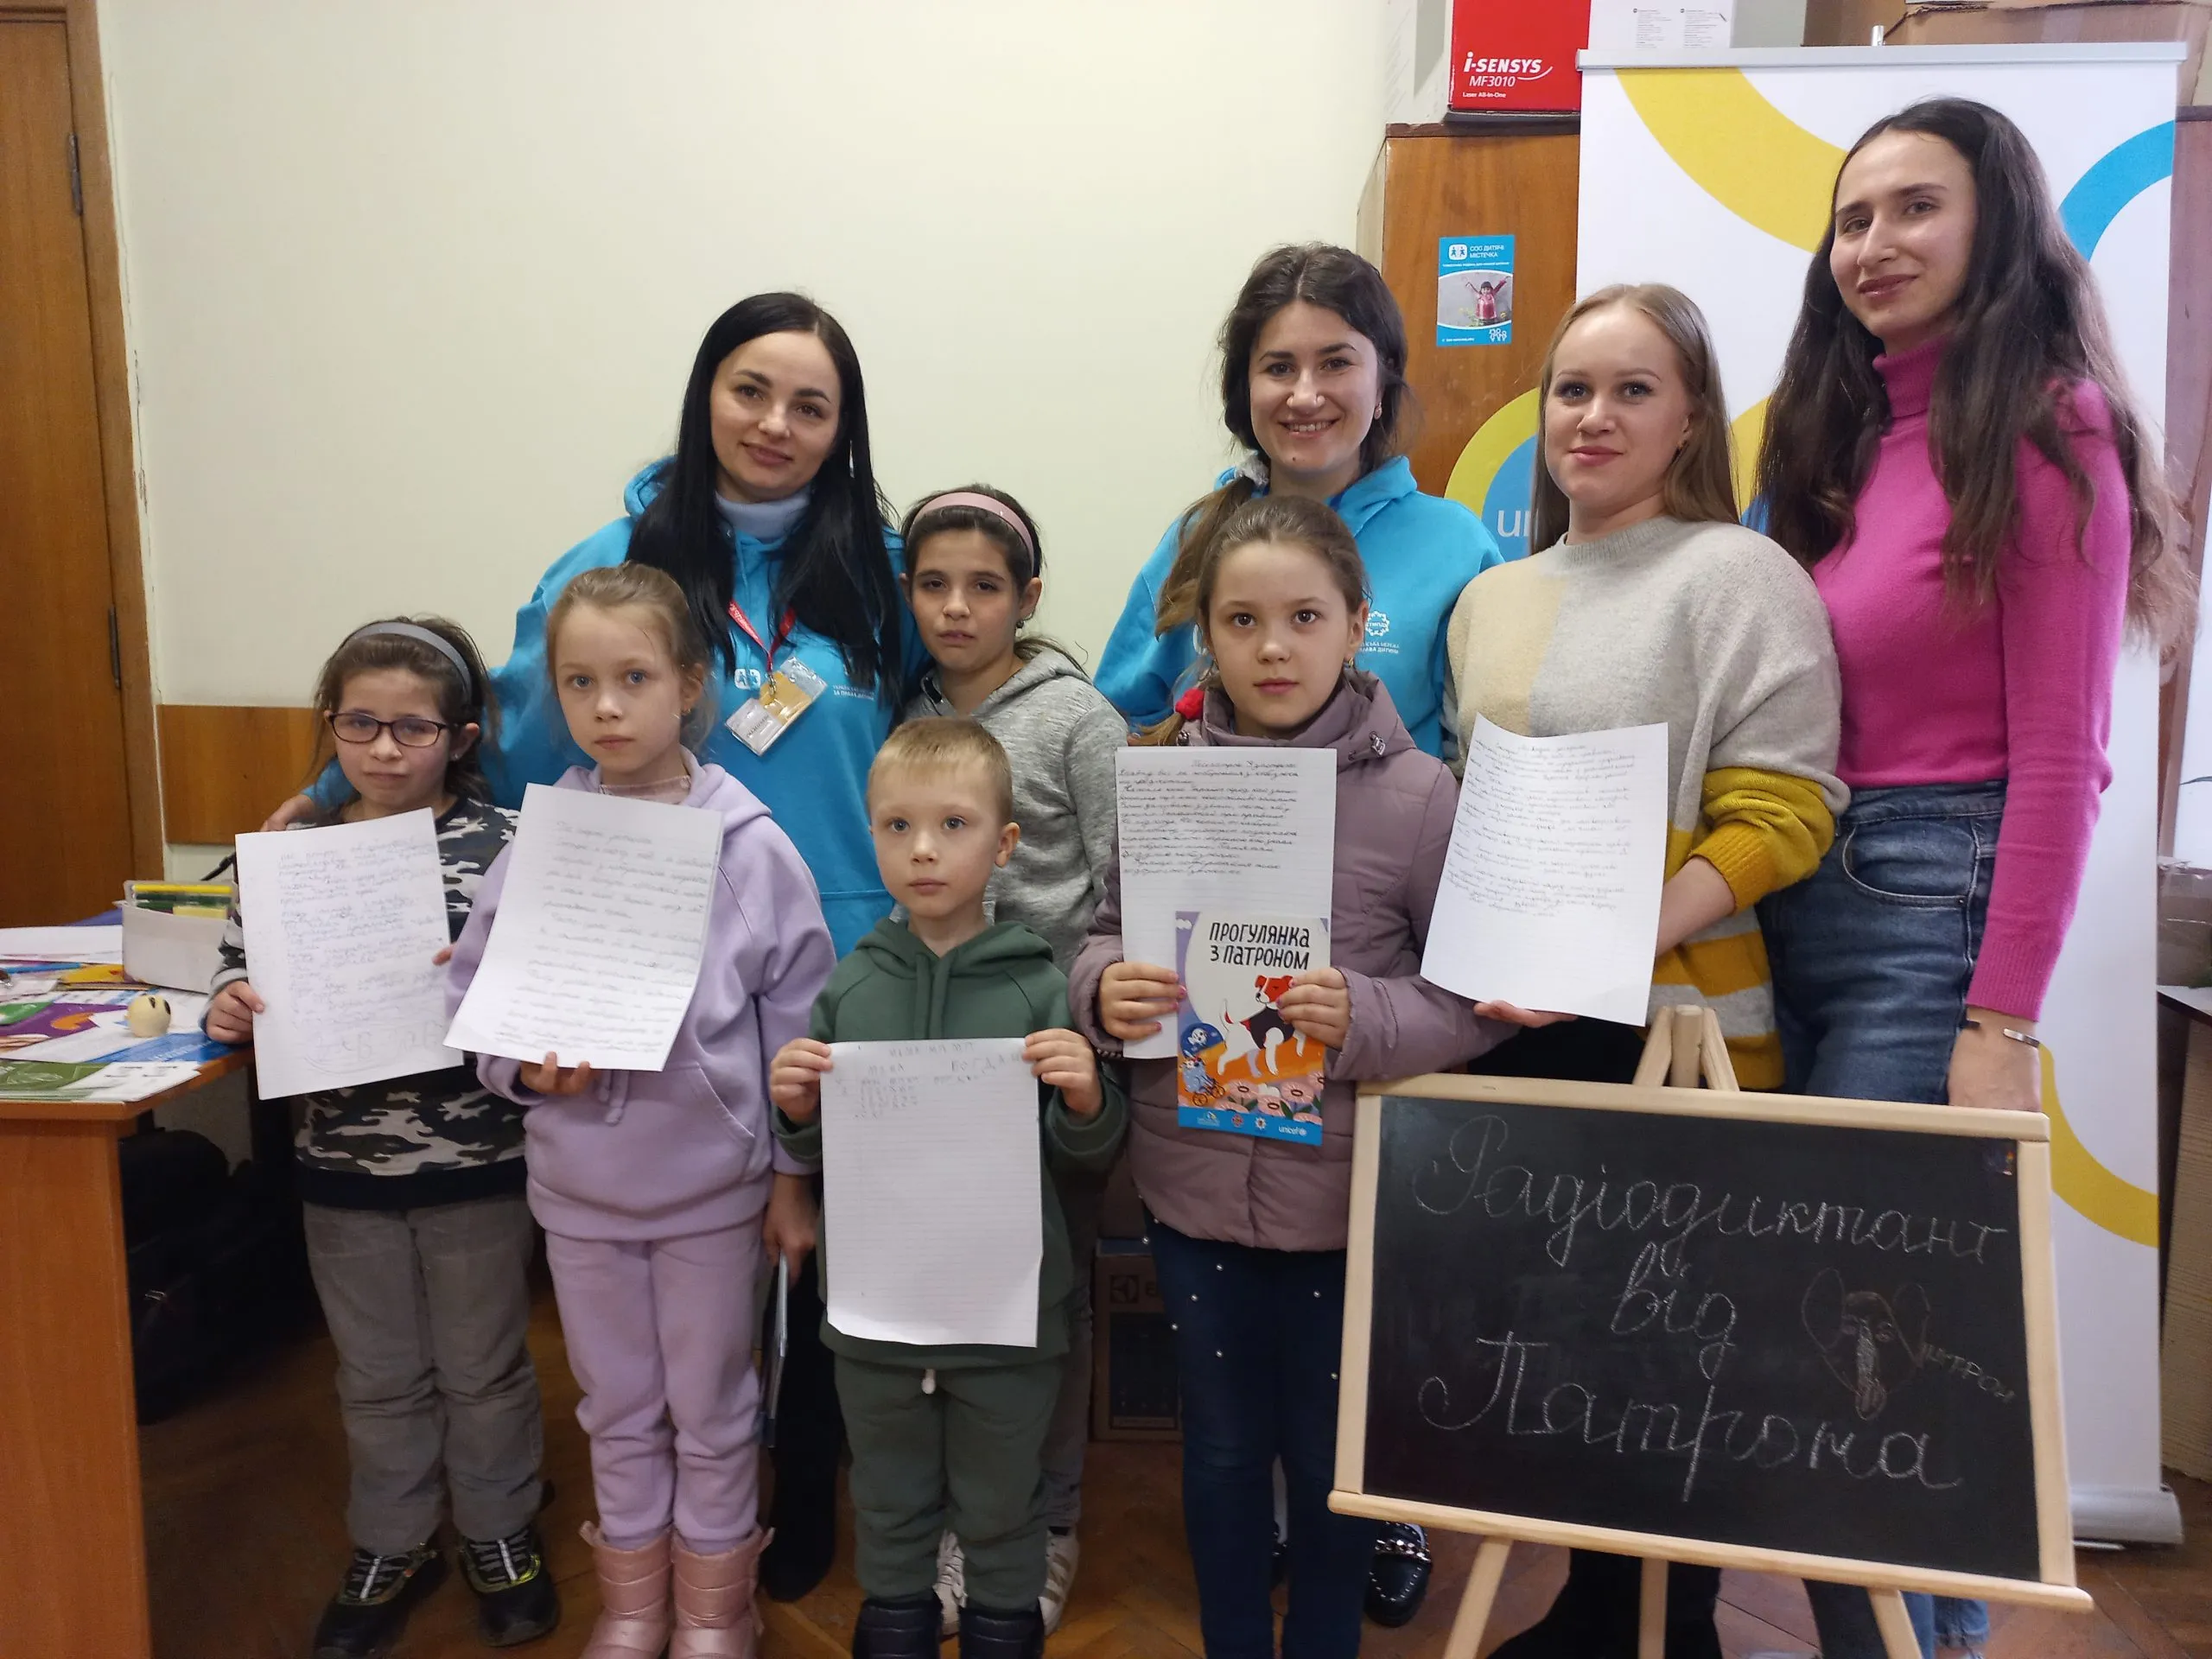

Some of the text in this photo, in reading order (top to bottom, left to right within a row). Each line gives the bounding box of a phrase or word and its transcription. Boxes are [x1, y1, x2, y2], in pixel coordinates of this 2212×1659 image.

[1463, 51, 1542, 73] i-SENSYS
[1469, 75, 1516, 87] MF3010
[1611, 1241, 1739, 1380] від
[1417, 1331, 1963, 1503] Патрона
